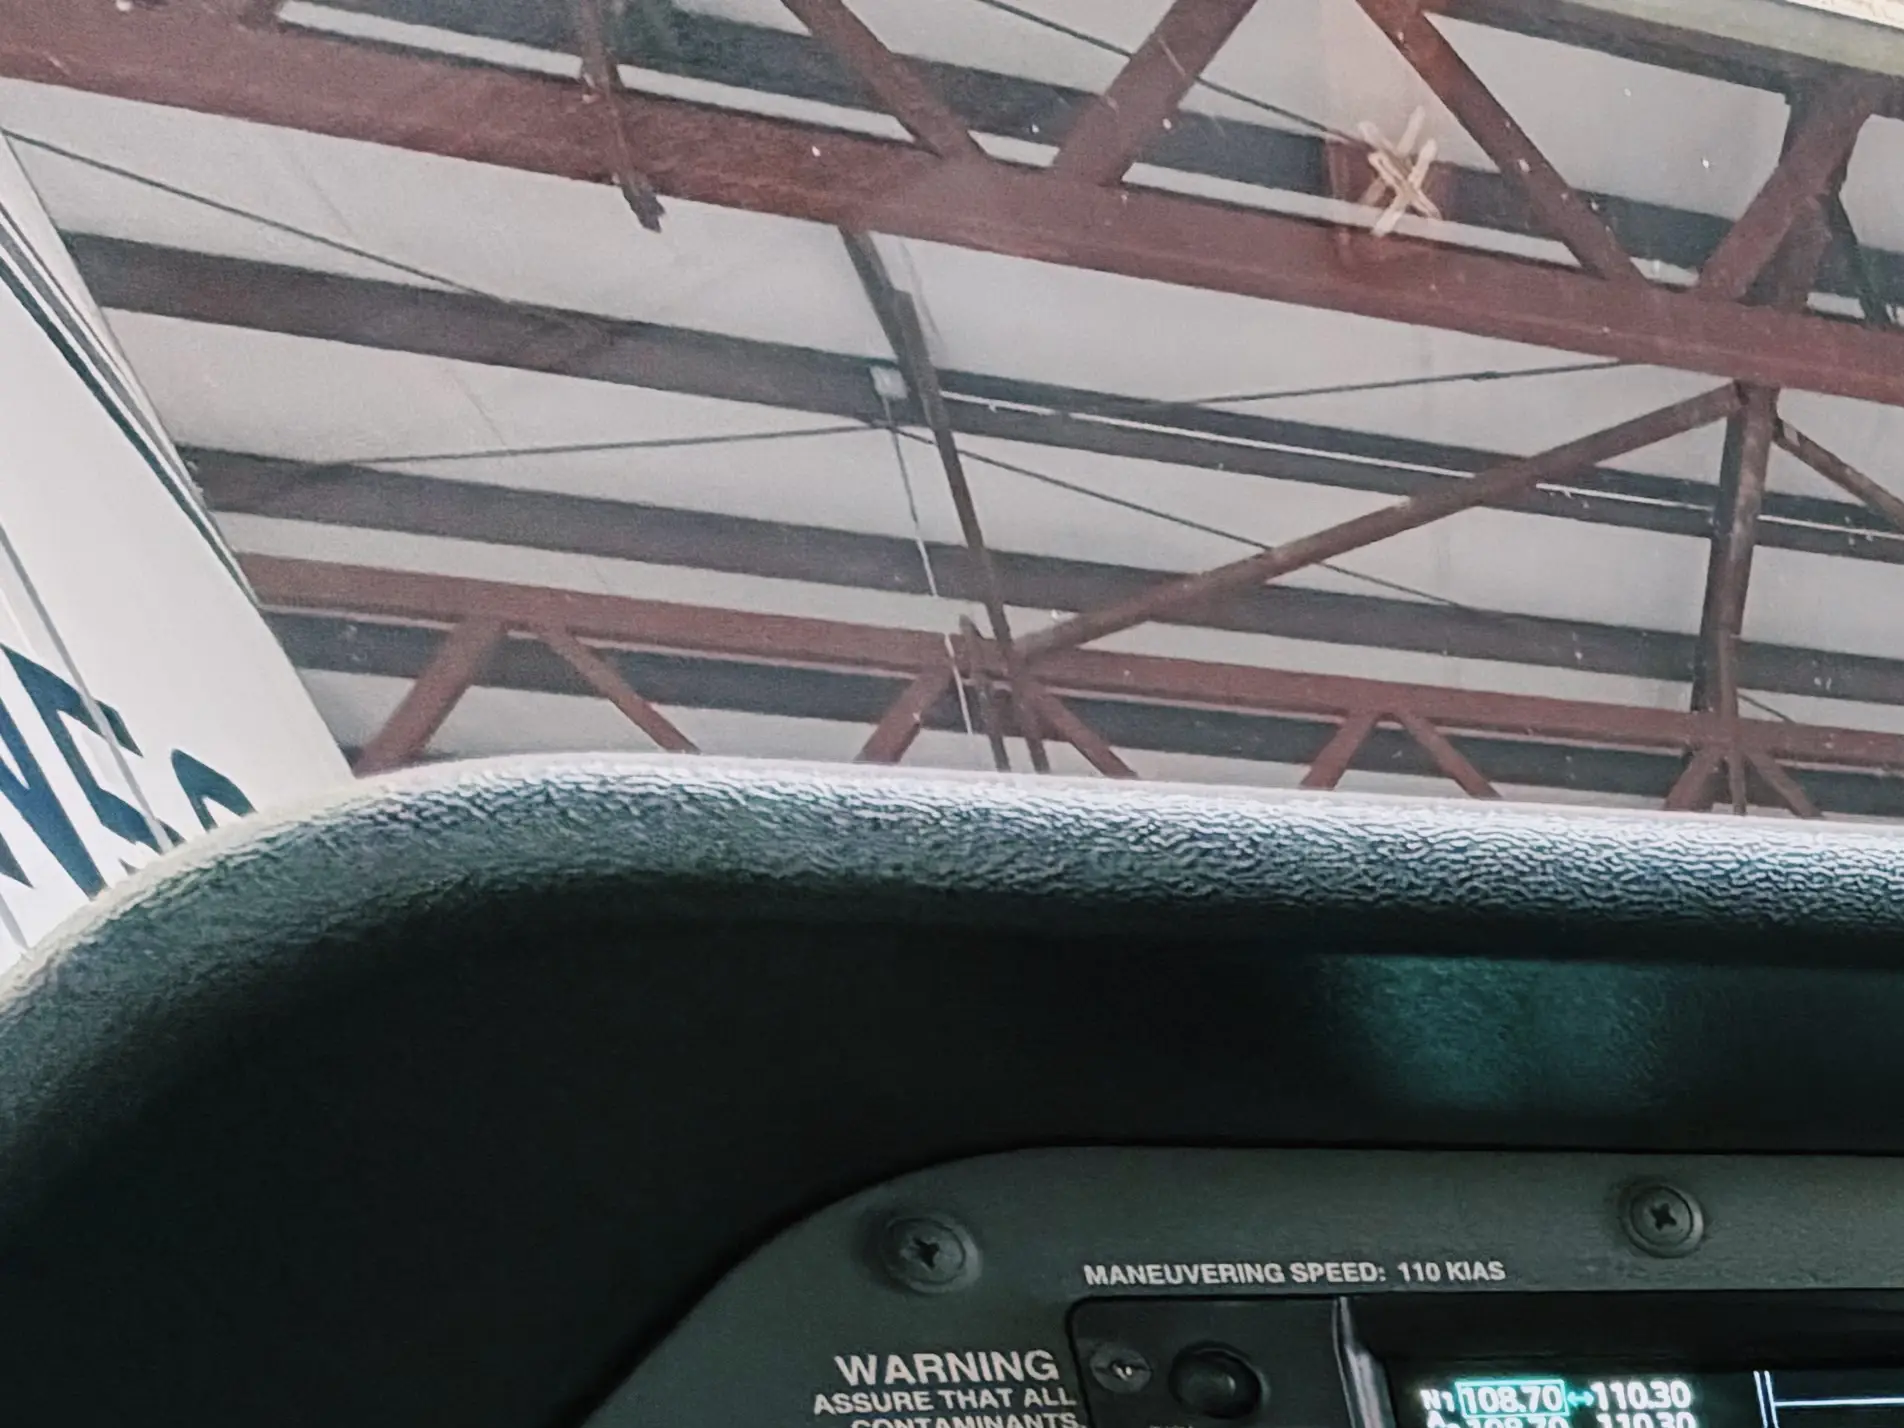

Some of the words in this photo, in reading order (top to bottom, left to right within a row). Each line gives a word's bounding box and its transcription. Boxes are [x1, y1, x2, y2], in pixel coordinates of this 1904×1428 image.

[1083, 1263, 1286, 1285] MANEUVERING
[1289, 1262, 1386, 1283] SPEED:
[1397, 1262, 1441, 1282] 110
[1445, 1260, 1506, 1281] KIAS
[834, 1349, 1059, 1386] WARNING
[813, 1390, 935, 1415] ASSURE
[937, 1387, 1013, 1410] THAT
[1024, 1387, 1076, 1407] ALL
[1461, 1386, 1562, 1413] 108.70
[1595, 1381, 1691, 1410] 110.30
